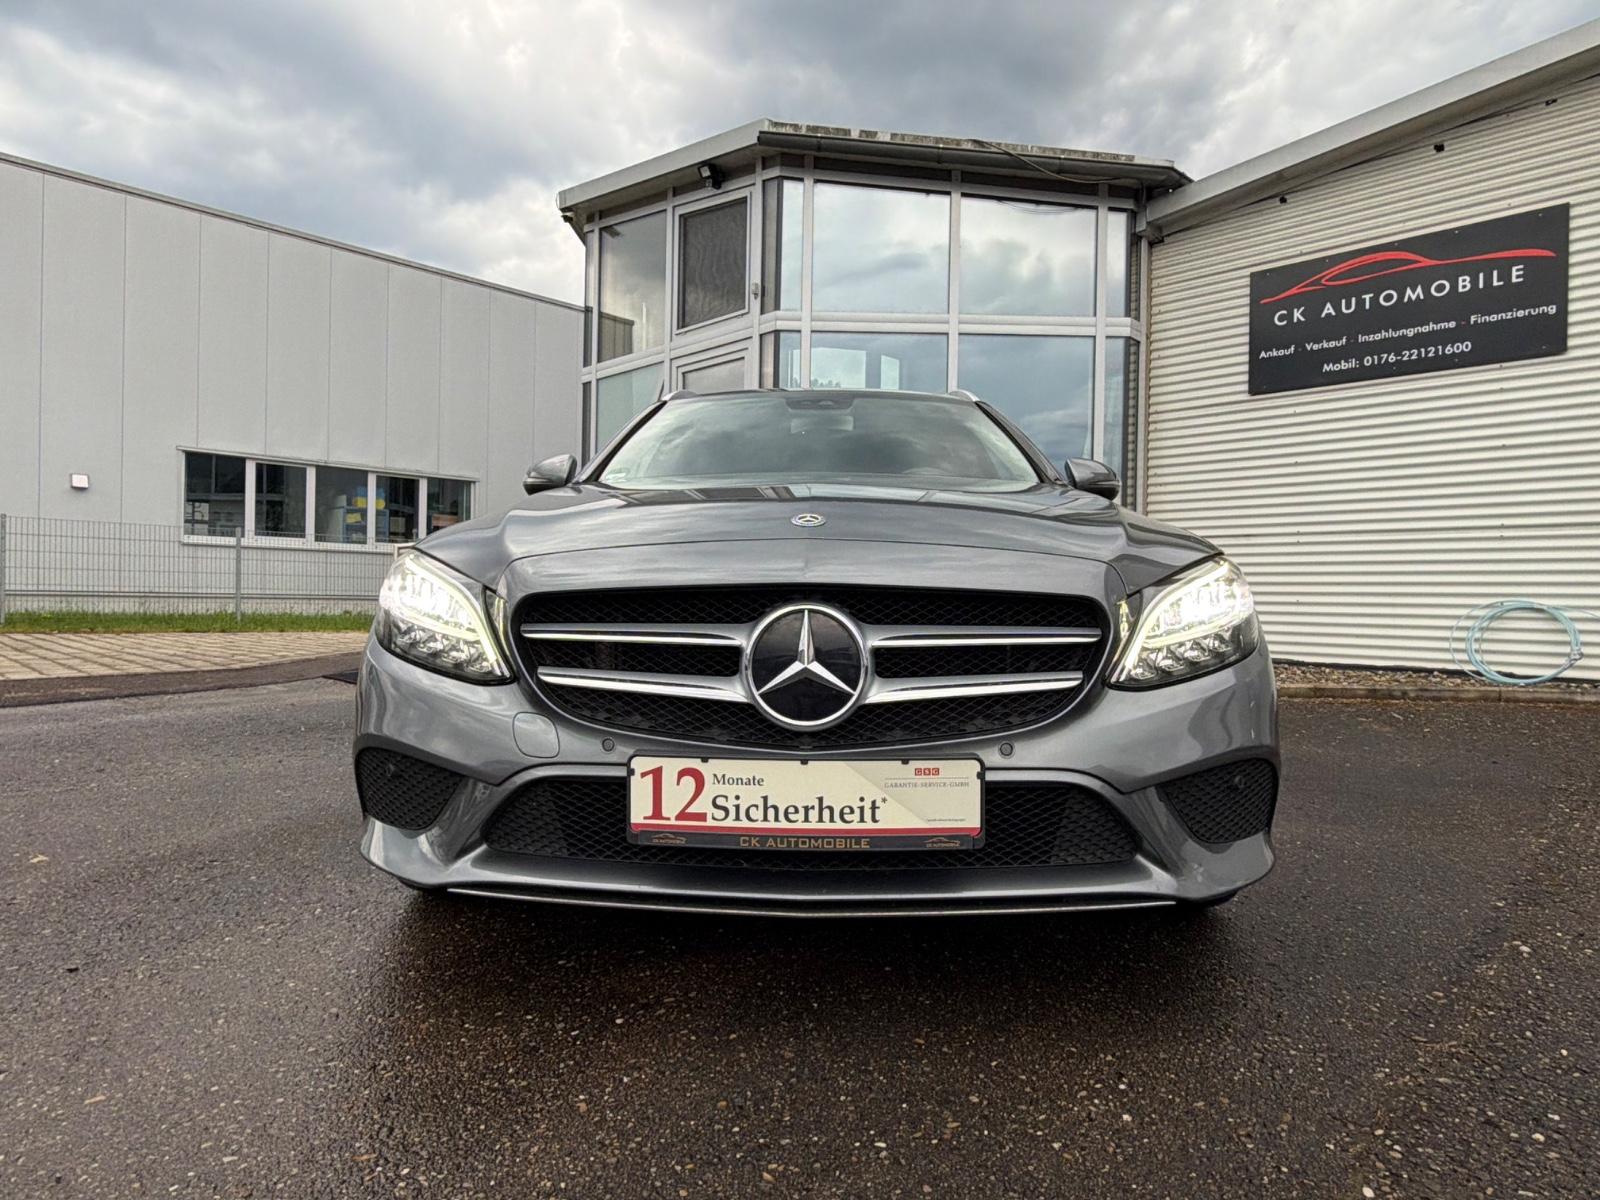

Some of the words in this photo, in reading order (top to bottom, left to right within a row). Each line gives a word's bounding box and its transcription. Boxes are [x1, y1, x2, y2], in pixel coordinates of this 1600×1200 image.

[1274, 306, 1306, 326] CK
[1321, 265, 1525, 318] AUTOMOBILE
[1259, 345, 1295, 360] Ankauf
[1305, 336, 1347, 352] Verkauf
[1358, 321, 1456, 343] Inzahlungnahme
[1470, 304, 1557, 325] Finanzierung
[1322, 359, 1360, 373] Mobil:
[1363, 341, 1472, 367] 0176-22121600
[712, 773, 765, 787] Monate
[914, 767, 940, 776] GSG
[640, 765, 708, 822] 12
[740, 836, 761, 848] CK
[766, 838, 871, 849] AUTOMOBILE
